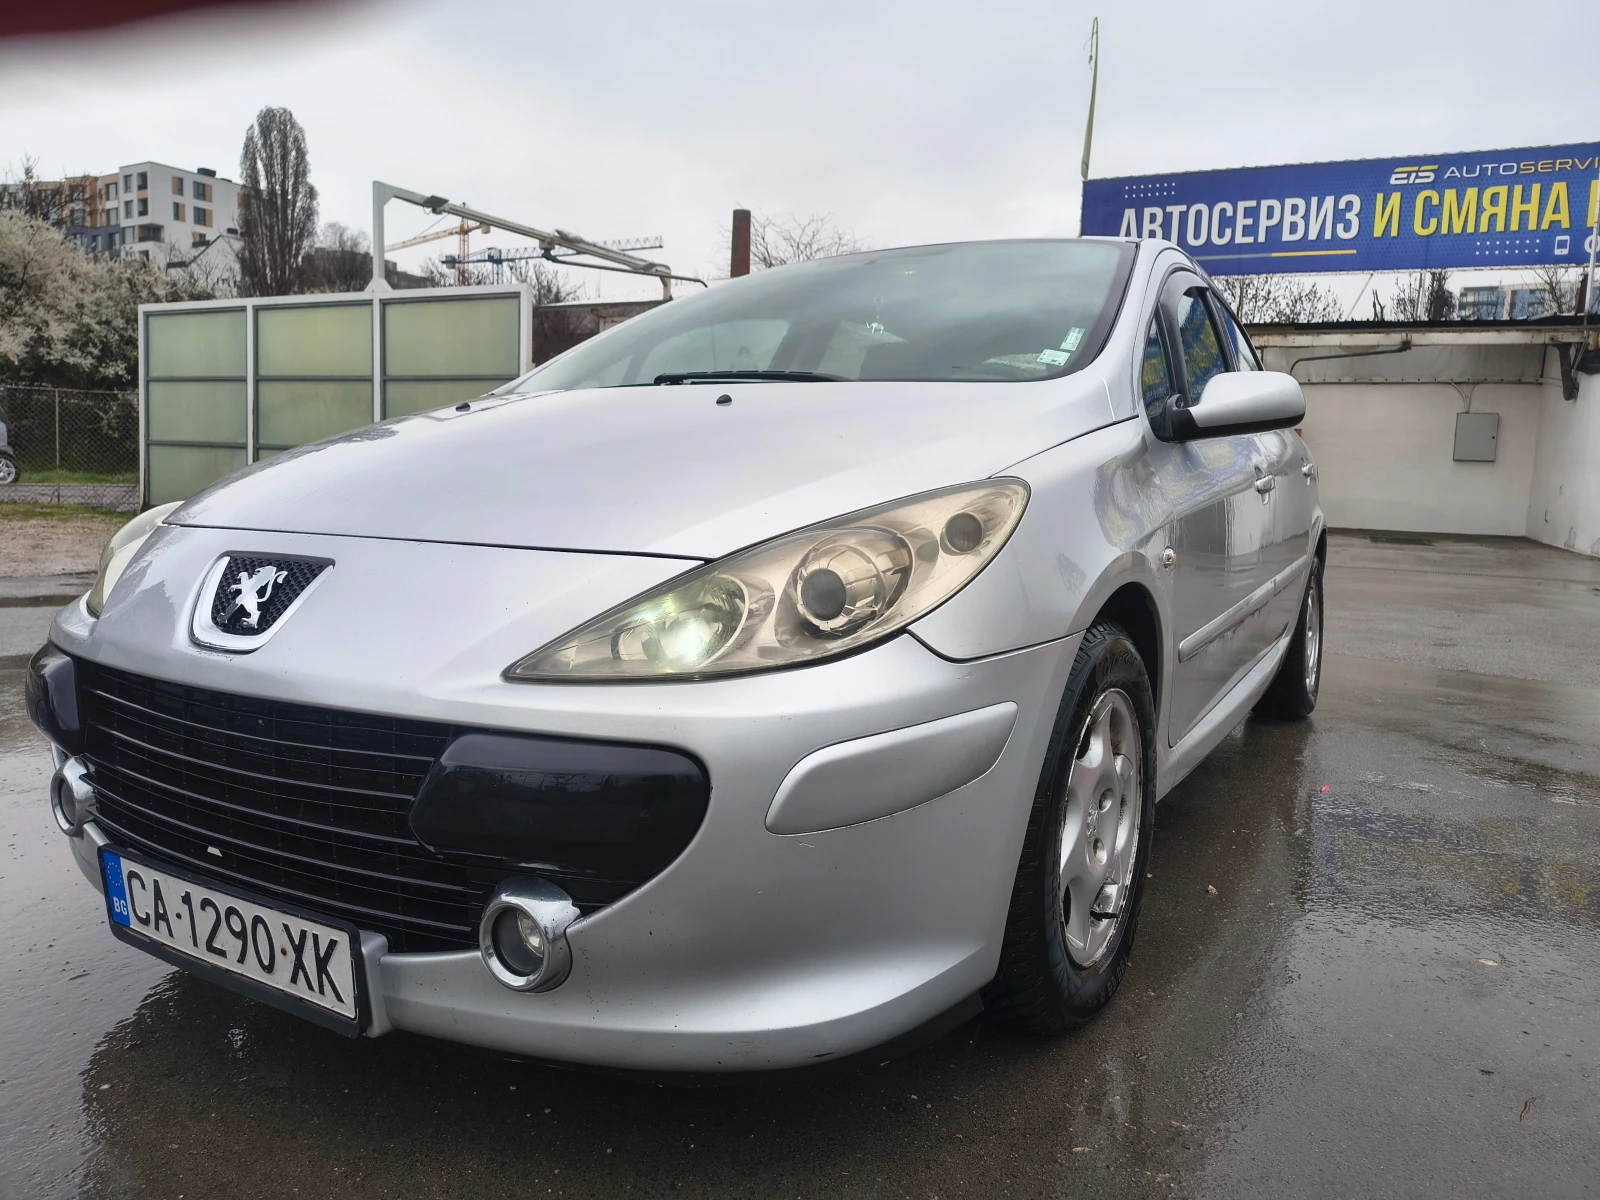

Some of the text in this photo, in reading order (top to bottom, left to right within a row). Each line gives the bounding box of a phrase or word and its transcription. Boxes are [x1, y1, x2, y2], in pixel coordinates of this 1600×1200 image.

[1118, 193, 1361, 247] АВТОСЕРВИЗ
[1373, 191, 1402, 238] И
[1413, 181, 1571, 236] СМЯНА
[112, 896, 128, 917] BG
